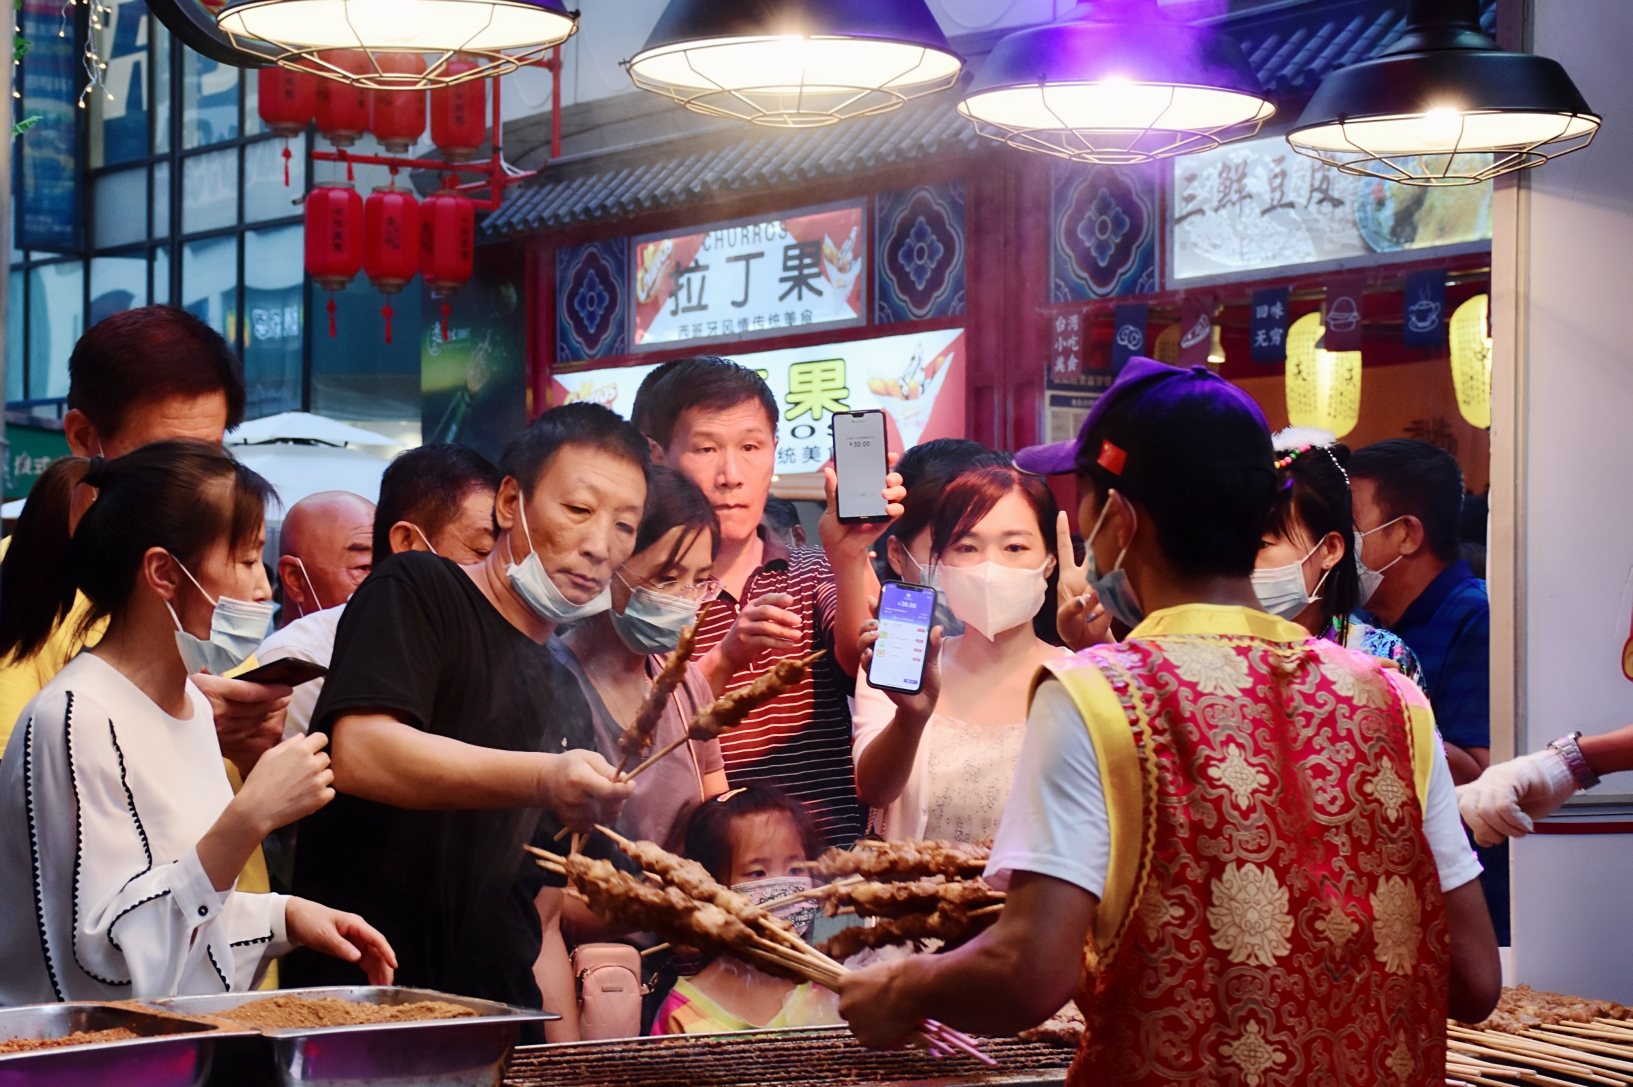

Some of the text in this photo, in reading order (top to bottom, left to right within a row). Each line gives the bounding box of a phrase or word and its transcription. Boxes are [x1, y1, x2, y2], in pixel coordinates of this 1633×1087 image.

[1175, 152, 1345, 225] 三鲜豆皮
[703, 222, 787, 252] CHURROS
[668, 239, 824, 317] 拉丁果
[1256, 301, 1284, 319] 回味
[678, 309, 813, 338] 西班牙风情传统美食
[1055, 314, 1079, 333] 台湾
[1054, 335, 1079, 352] 小吃
[1253, 327, 1283, 347] 无穷
[1054, 354, 1079, 373] 美食
[756, 358, 850, 421] 果
[777, 446, 834, 465] 统美
